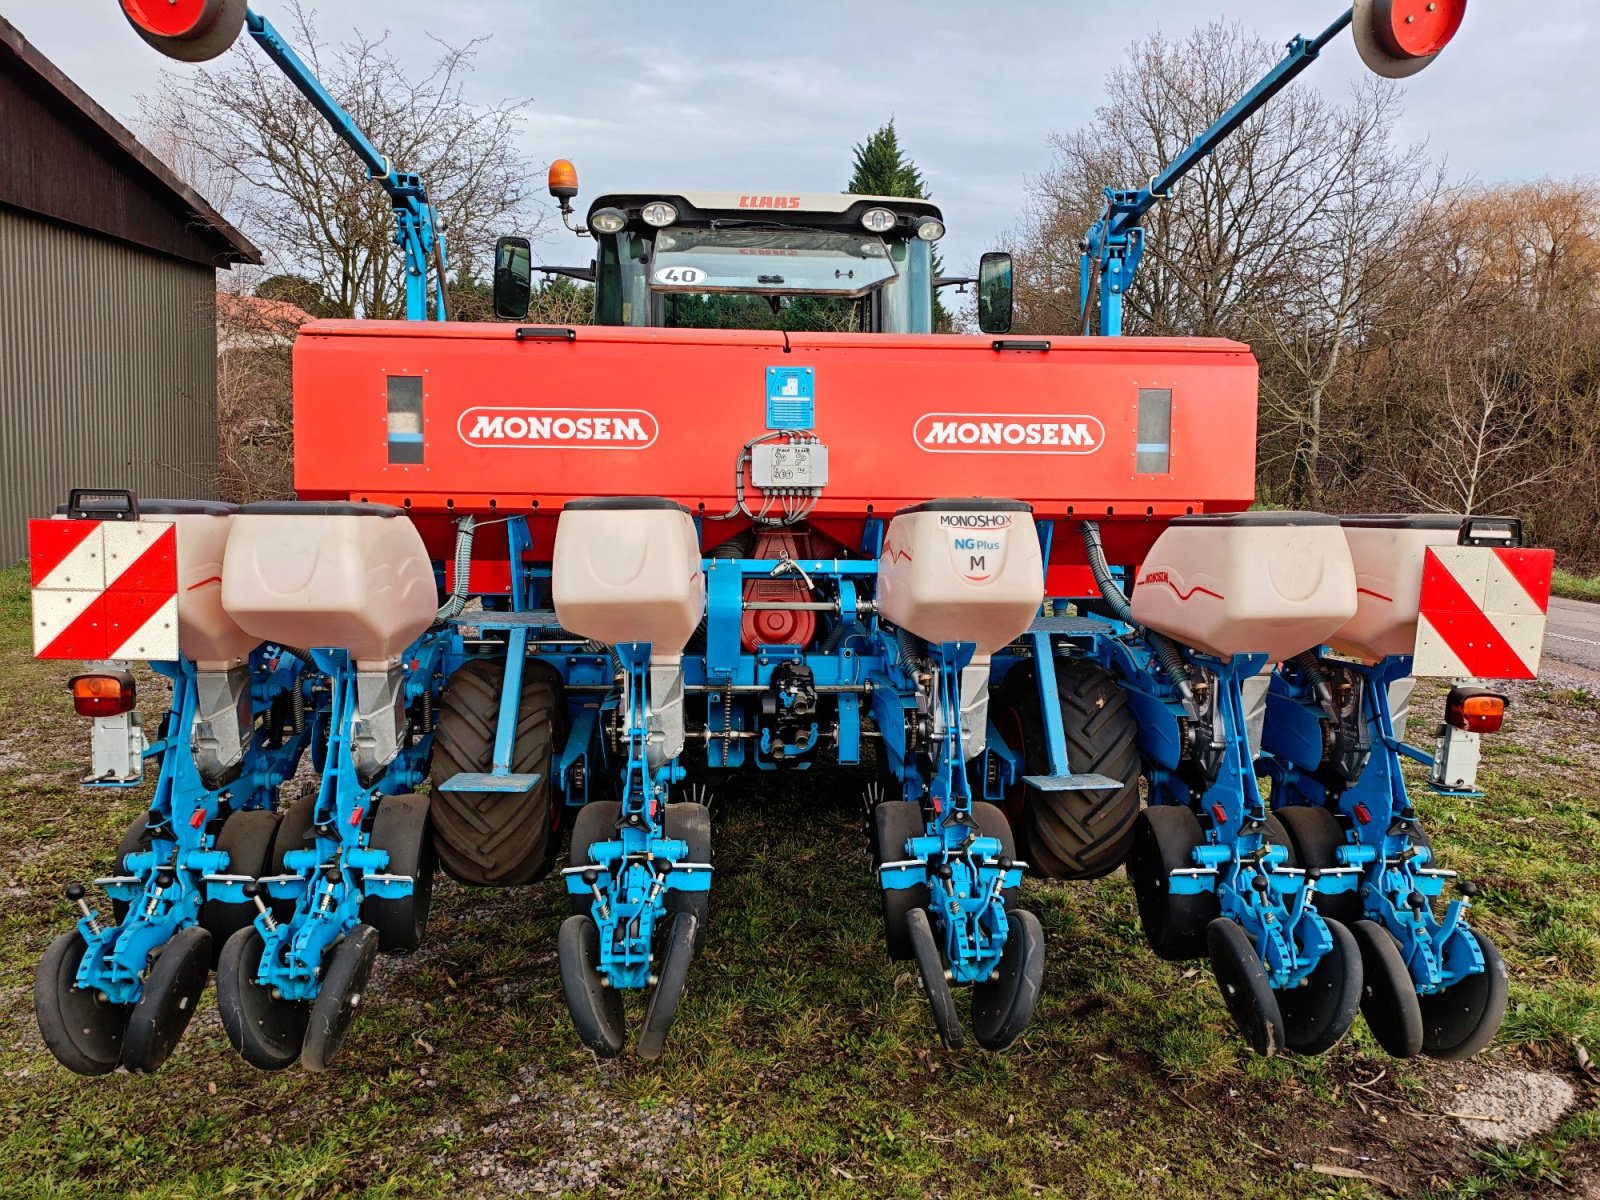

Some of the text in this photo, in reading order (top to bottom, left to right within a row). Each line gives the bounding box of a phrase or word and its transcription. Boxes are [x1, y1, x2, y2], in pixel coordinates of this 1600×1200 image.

[738, 195, 800, 208] CLAAS
[665, 269, 696, 283] 40
[469, 415, 649, 441] MONOSEM
[924, 421, 1095, 446] MONOSEM
[939, 514, 1013, 527] MONOSHOX
[954, 538, 1000, 550] NG Plus
[970, 556, 985, 571] M
